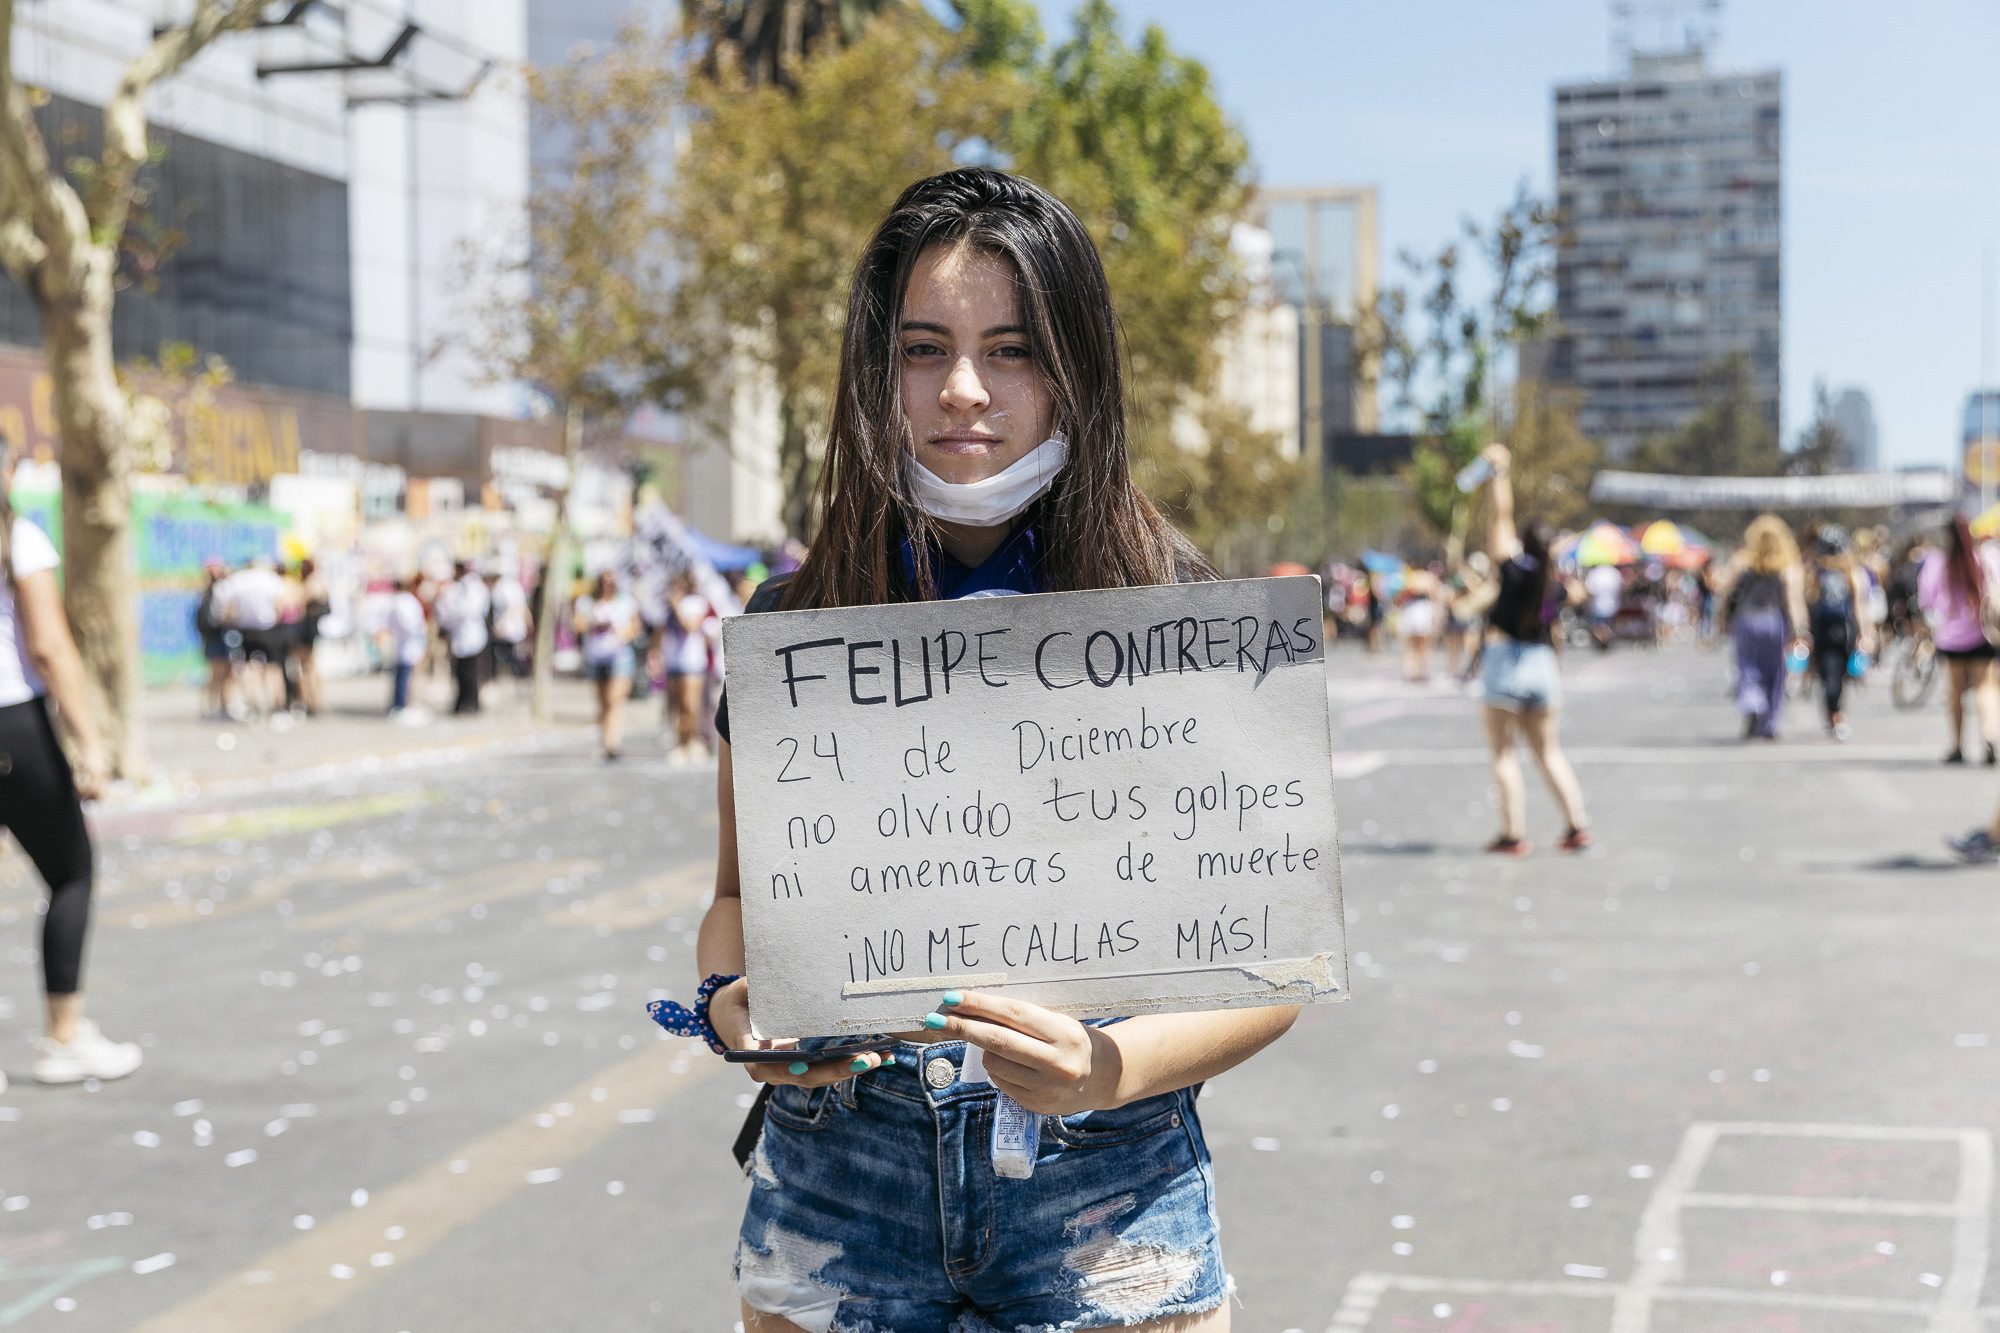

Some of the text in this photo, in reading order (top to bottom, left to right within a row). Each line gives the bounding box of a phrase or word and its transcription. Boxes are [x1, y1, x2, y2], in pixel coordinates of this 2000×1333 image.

[775, 616, 1318, 708] FELIPE CONTRERAS
[776, 706, 1199, 783] 24 de Diciembre
[787, 771, 1305, 850] no olvido tus golpes
[771, 833, 1320, 900] ni amenazas de muerte
[928, 922, 981, 974] ME
[1002, 918, 1140, 968] CALLAS
[1176, 904, 1270, 959] MÁS!
